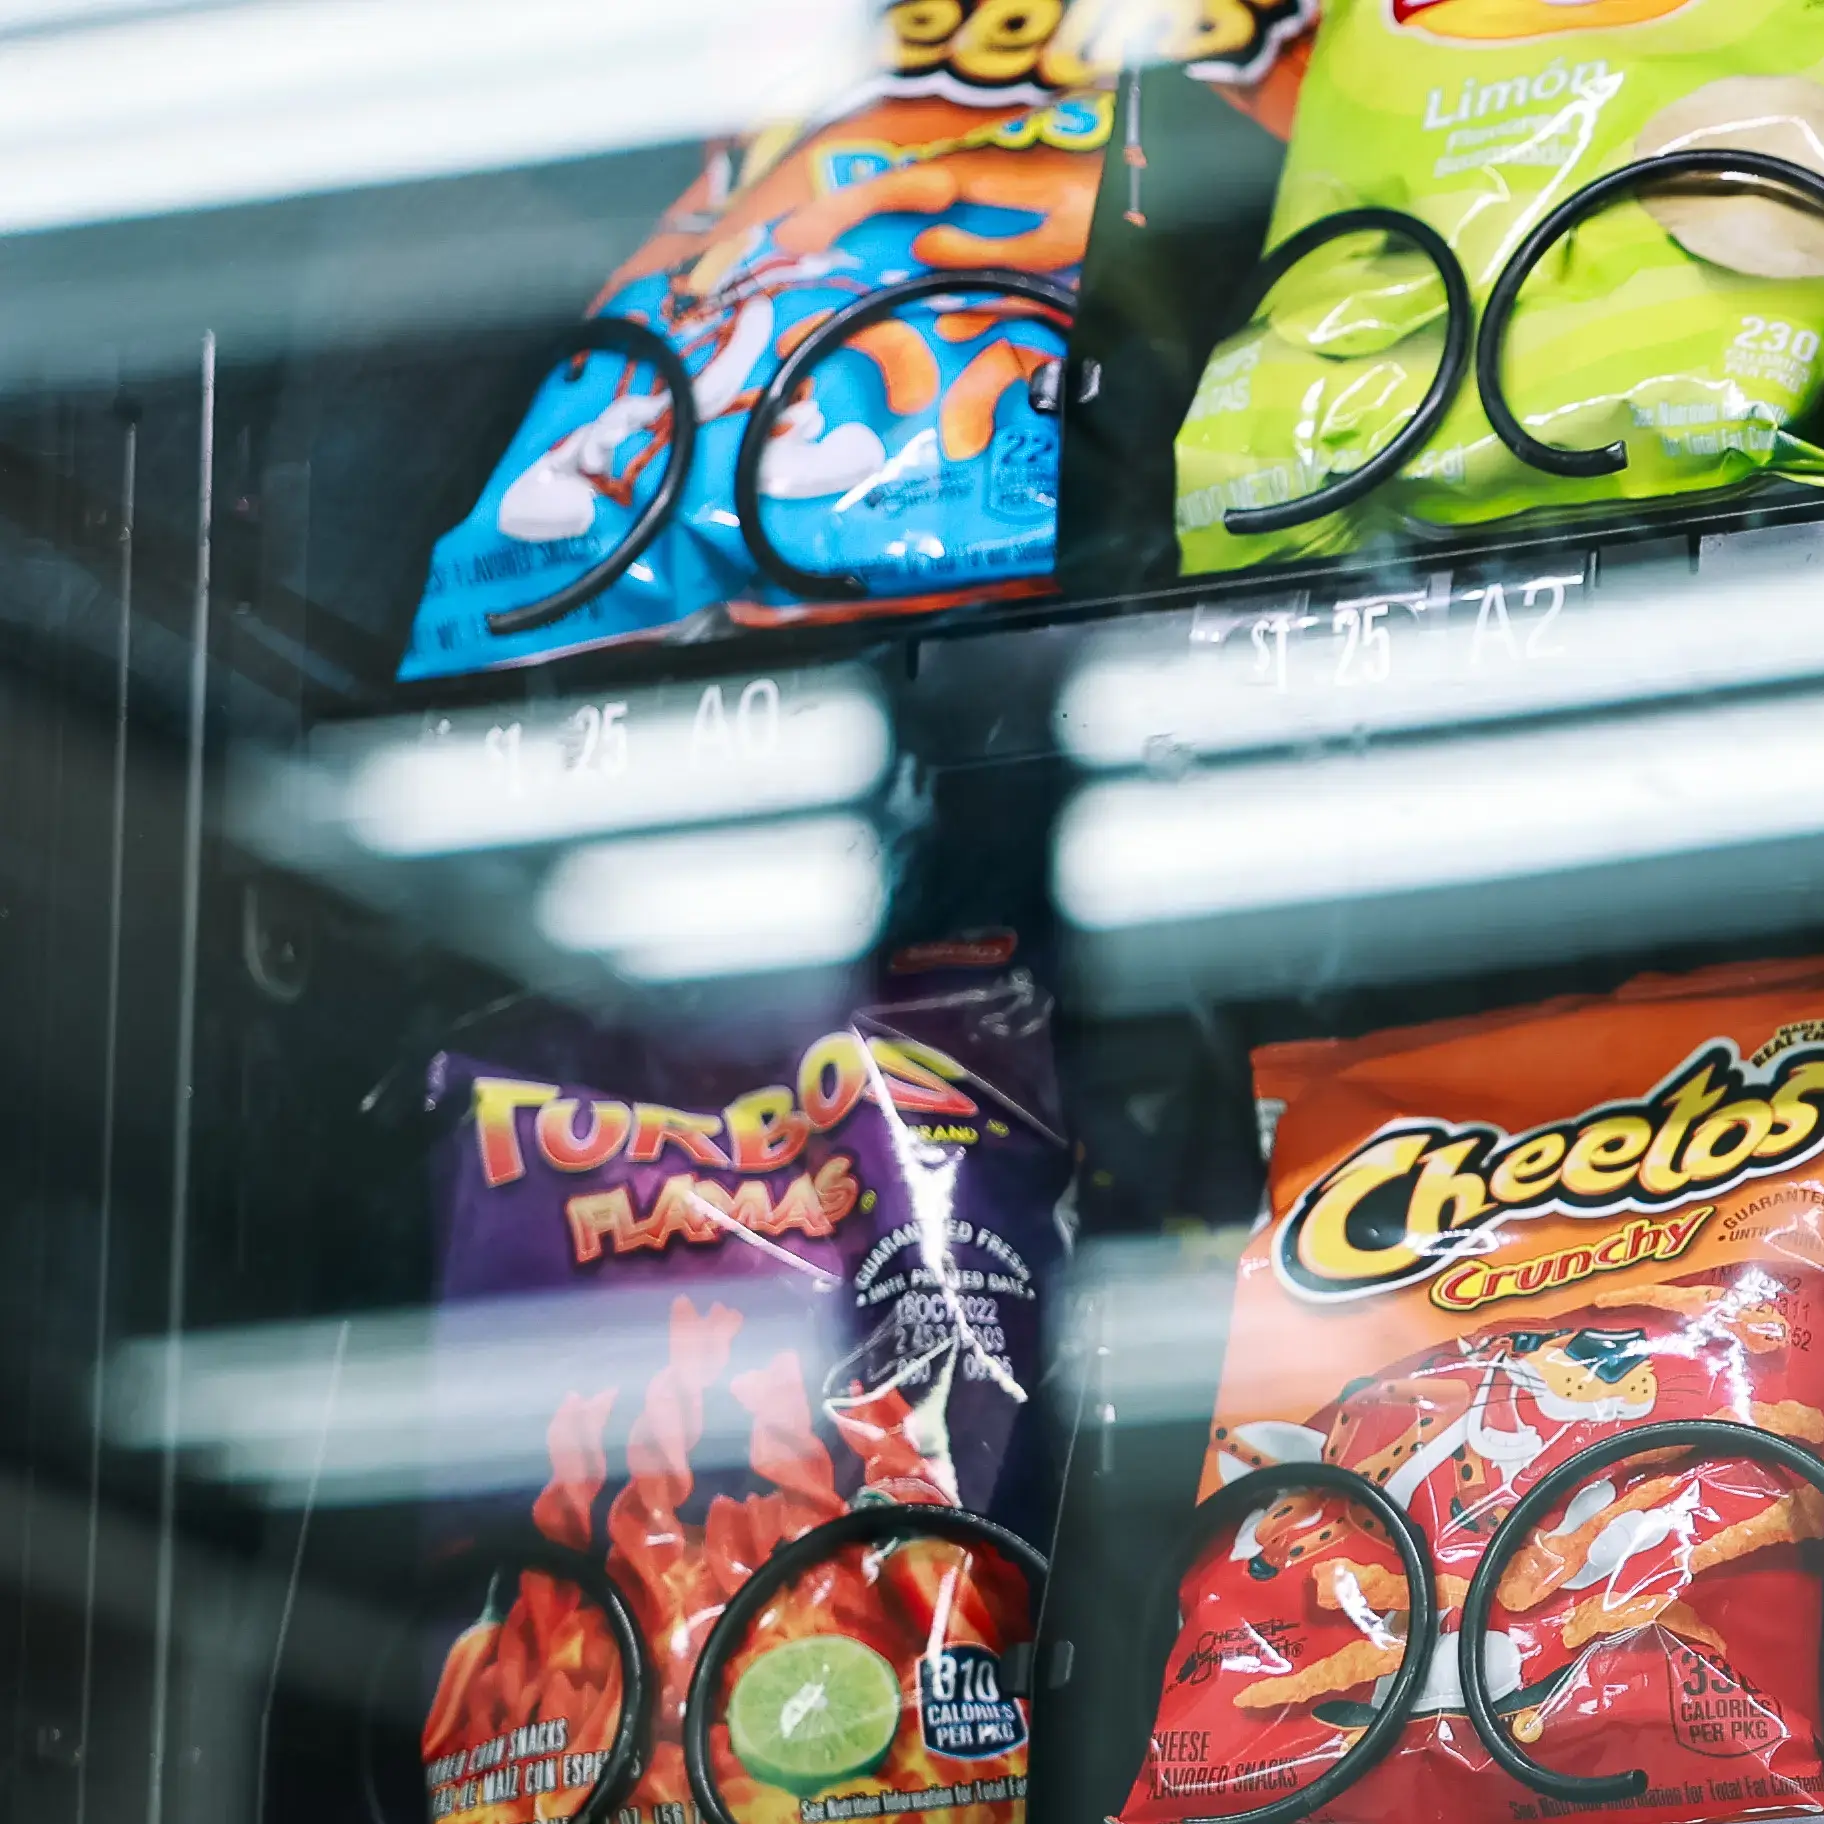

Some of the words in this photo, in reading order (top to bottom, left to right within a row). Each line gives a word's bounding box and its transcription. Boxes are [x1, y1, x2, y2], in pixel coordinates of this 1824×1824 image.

[1423, 57, 1608, 131] Limón
[1733, 315, 1819, 363] 230
[1468, 583, 1568, 668] A2
[689, 678, 780, 771] A0
[1752, 1033, 1797, 1068] REAL
[565, 1155, 862, 1265] FLAMAS
[1432, 1205, 1716, 1311] Crunchy
[927, 1702, 1017, 1726] CALORIES
[1681, 1699, 1771, 1723] CALORIES
[1689, 1723, 1724, 1744] PER
[1731, 1720, 1768, 1740] PKG
[508, 1716, 568, 1762] SNACKS
[936, 1724, 973, 1748] PER
[483, 1765, 520, 1805] MAIZ
[524, 1758, 557, 1796] CON
[1233, 1758, 1298, 1793] SNACKS
[1745, 1777, 1767, 1798] Fat
